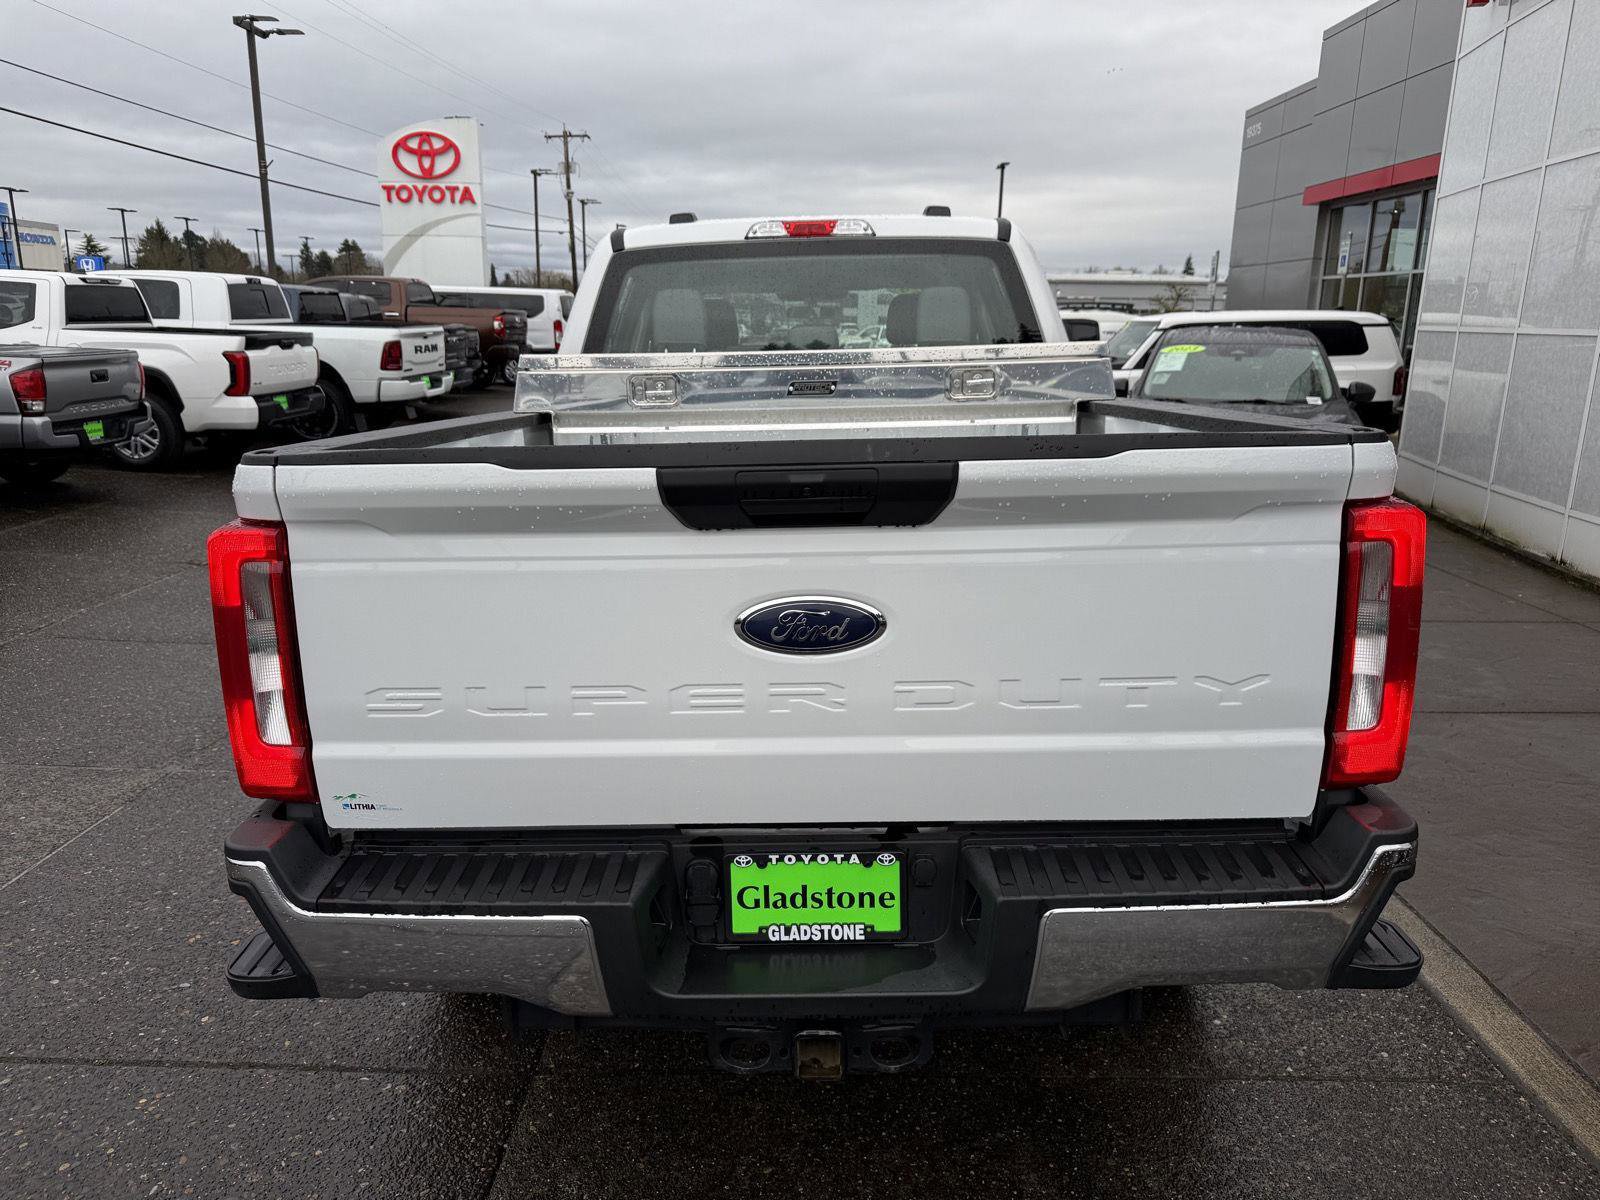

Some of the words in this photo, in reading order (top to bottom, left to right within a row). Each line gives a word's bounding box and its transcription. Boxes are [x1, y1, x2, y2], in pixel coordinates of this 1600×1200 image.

[381, 184, 477, 205] TOYOTA
[414, 344, 438, 354] RAM
[771, 609, 850, 642] Ford
[365, 683, 847, 717] SUPER
[894, 674, 1271, 711] DUTY
[769, 854, 861, 865] TOYOTA
[736, 884, 896, 909] Gladstone
[768, 924, 865, 941] GLADSTONE
